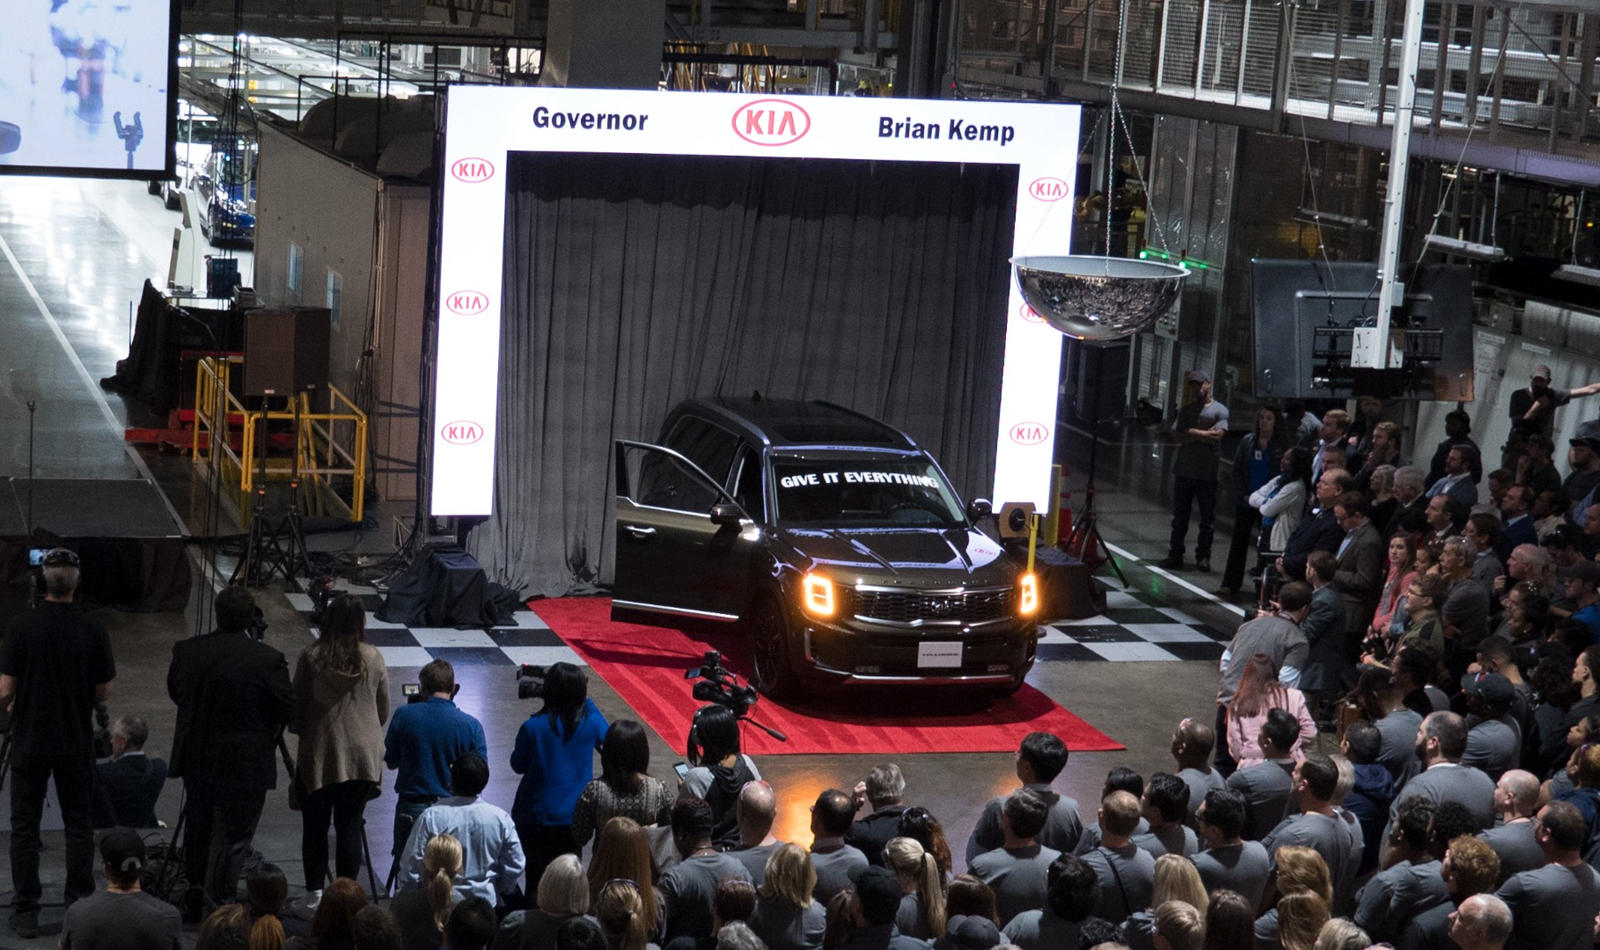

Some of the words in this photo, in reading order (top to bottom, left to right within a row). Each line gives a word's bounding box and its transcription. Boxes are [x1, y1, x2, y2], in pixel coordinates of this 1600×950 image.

[532, 106, 649, 131] Governor
[745, 109, 797, 136] KIA
[878, 115, 941, 140] Brian
[948, 118, 1015, 147] Kemp
[459, 163, 488, 177] KIA
[1035, 182, 1062, 197] KIA
[453, 295, 482, 310] KIA
[448, 426, 477, 440] KIA
[780, 474, 820, 488] GIVE
[823, 473, 839, 485] IT
[843, 472, 939, 489] EVERYTHING
